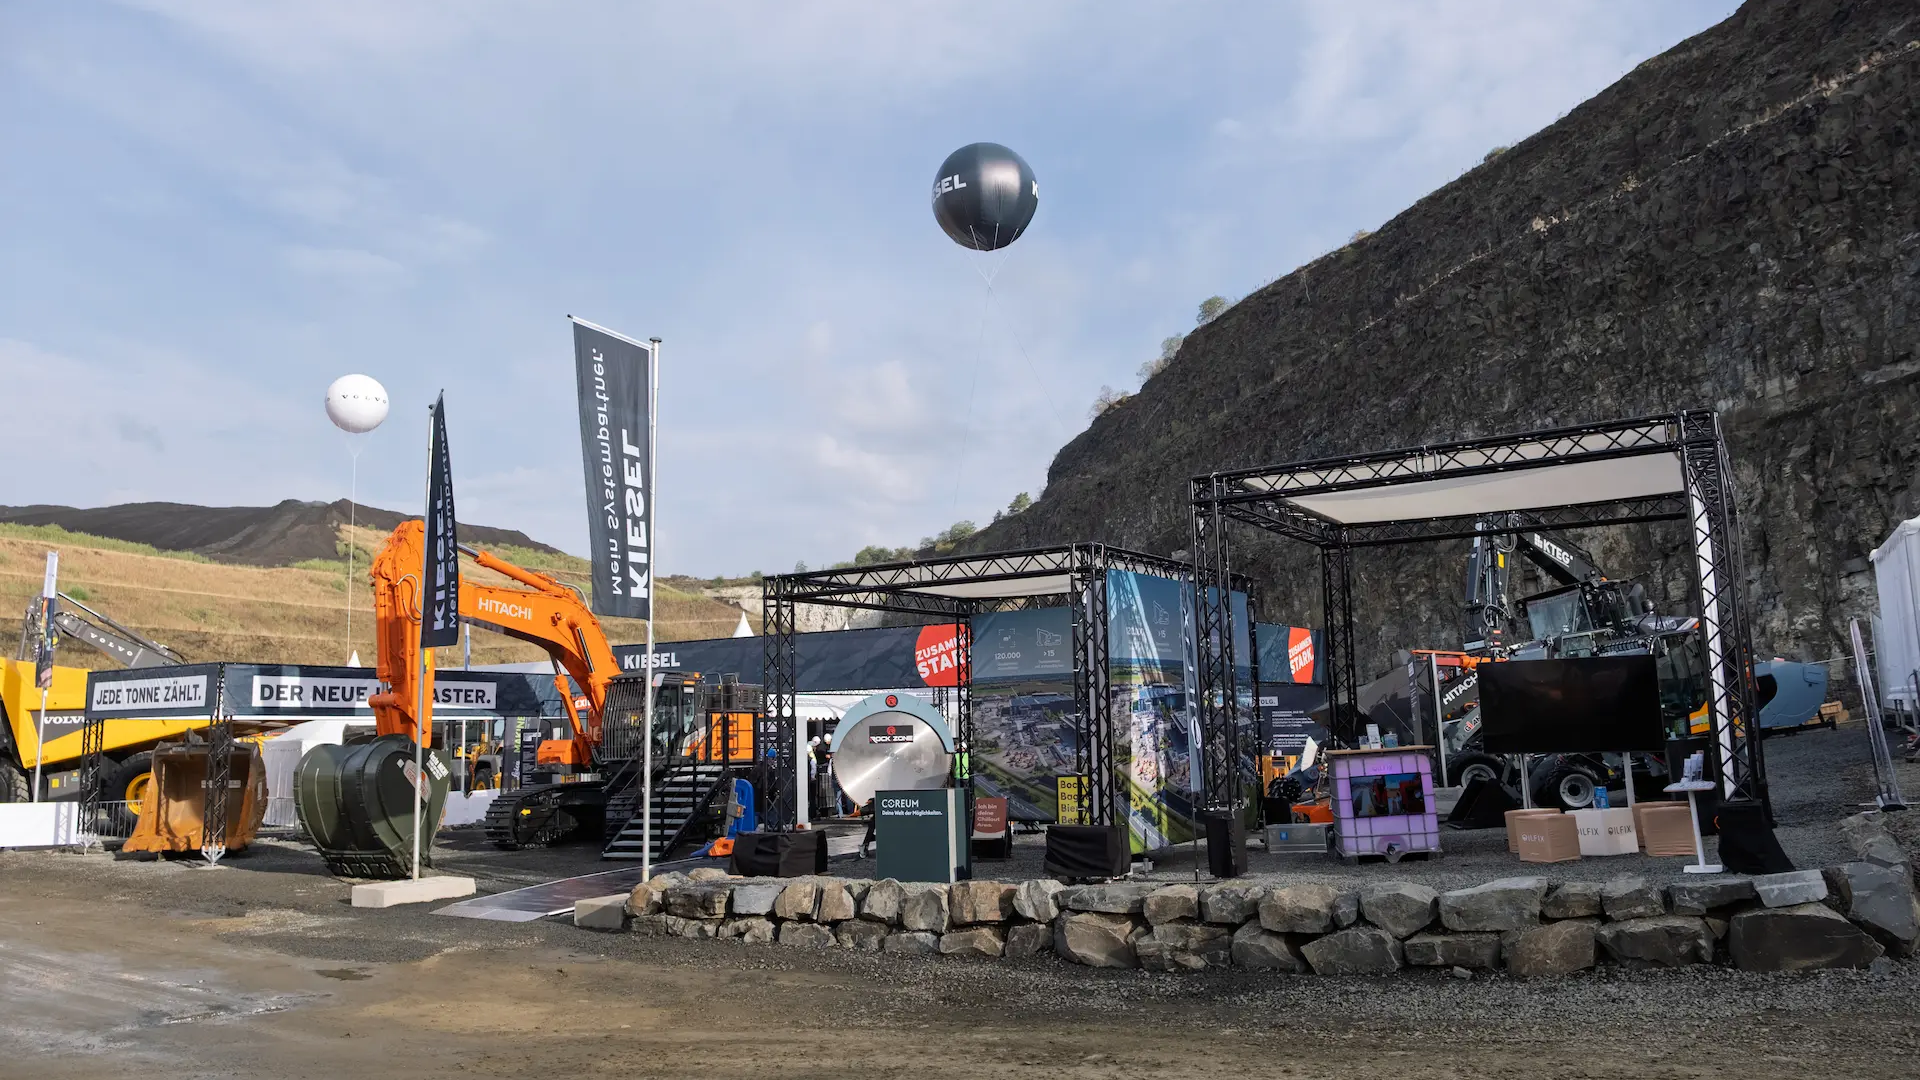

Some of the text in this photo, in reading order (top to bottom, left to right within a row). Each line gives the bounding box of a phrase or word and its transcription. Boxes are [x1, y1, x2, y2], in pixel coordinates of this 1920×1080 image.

[433, 485, 446, 631] KIESEL
[449, 580, 458, 629] Mein
[478, 597, 532, 621] HITACHI
[90, 632, 134, 657] VOLVO
[995, 651, 1021, 660] 120.000
[1290, 646, 1315, 675] STARK.
[96, 681, 202, 705] JEDE TONNE ZÄHLT.
[260, 684, 304, 701] DER
[312, 686, 368, 702] NEUE
[1442, 672, 1479, 705] HITACH
[869, 735, 891, 744] ROCK
[1060, 780, 1078, 789] Boc
[881, 799, 920, 809] COREUM
[1578, 827, 1600, 836] ILFIX
